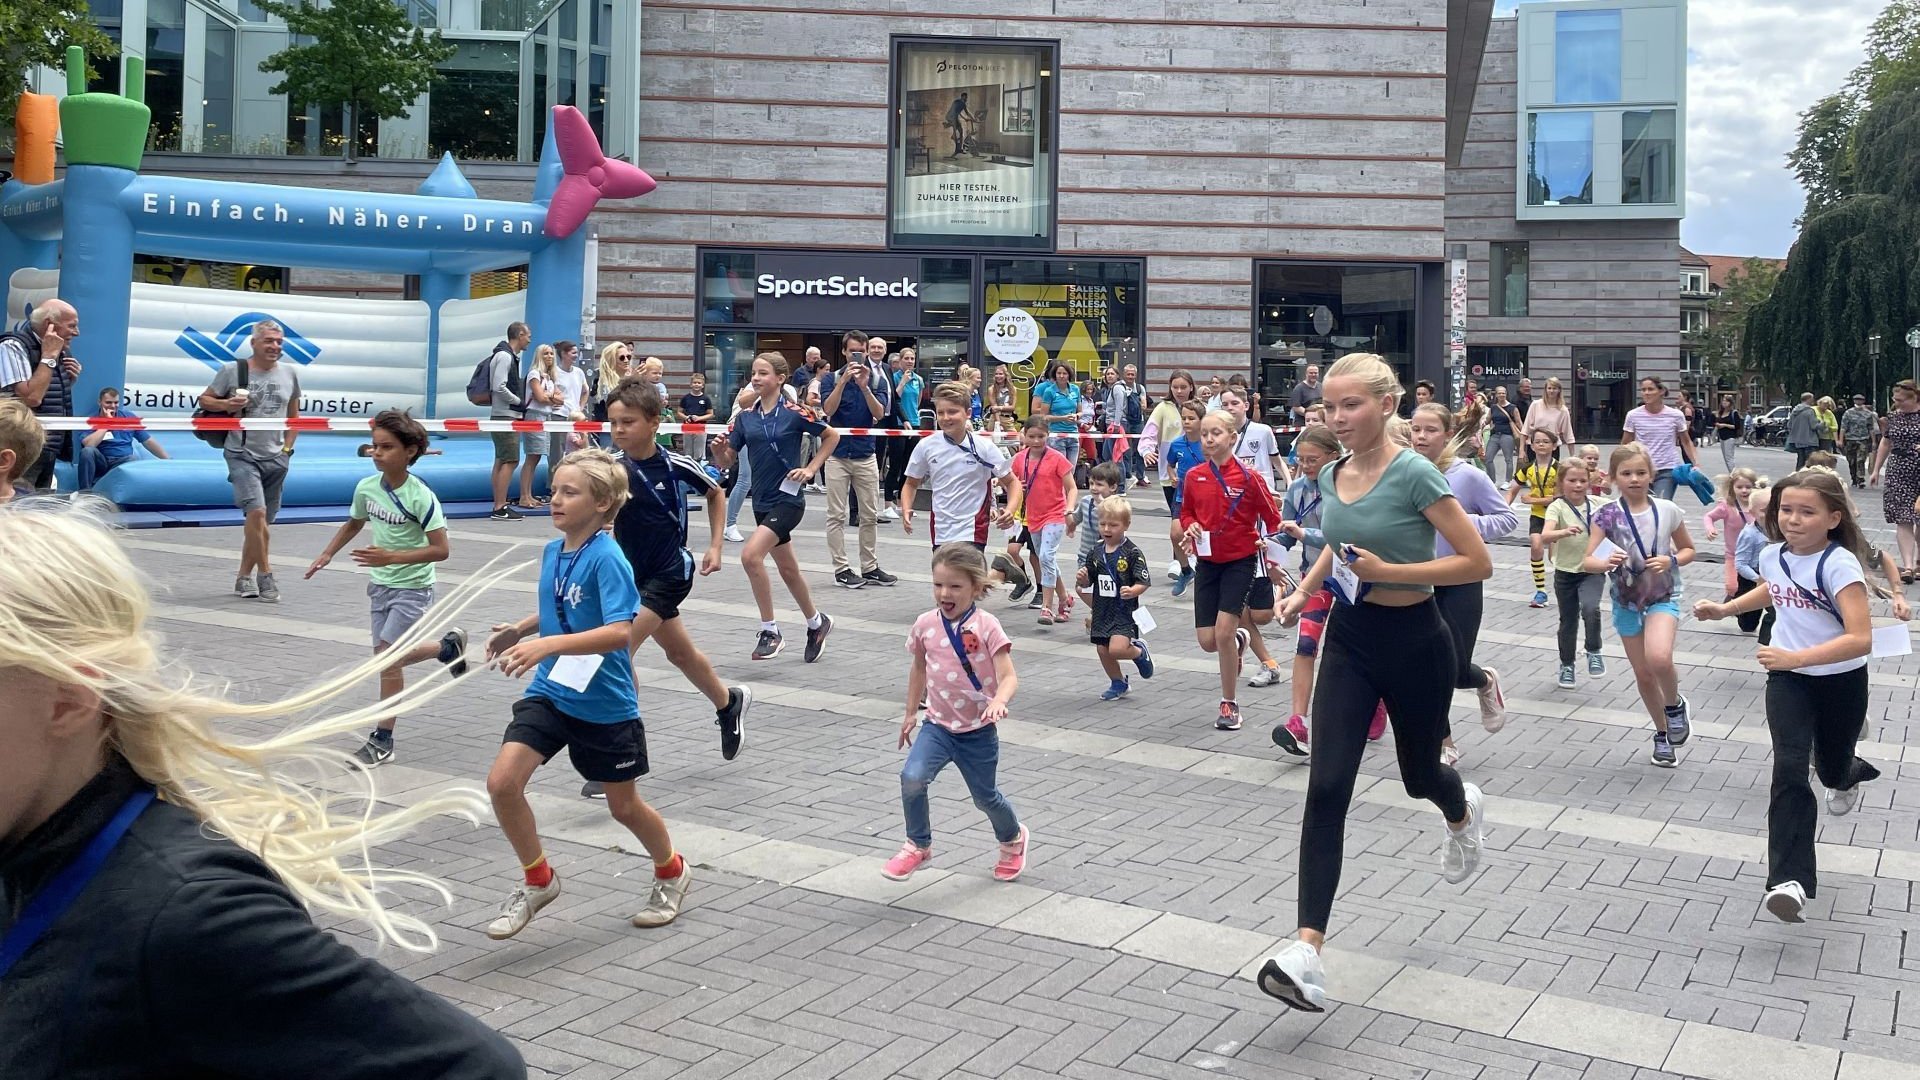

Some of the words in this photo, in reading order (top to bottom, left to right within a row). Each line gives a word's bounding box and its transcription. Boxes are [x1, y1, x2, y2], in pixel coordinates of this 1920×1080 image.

[939, 183, 961, 191] HIER
[964, 184, 1000, 192] TESTEN.
[917, 193, 960, 202] ZUHAUSE
[963, 194, 1022, 204] TRAINIEREN.
[143, 192, 304, 224] Einfach.
[328, 206, 443, 230] Näher.
[463, 213, 545, 235] Dran.
[757, 273, 918, 298] SportScheck
